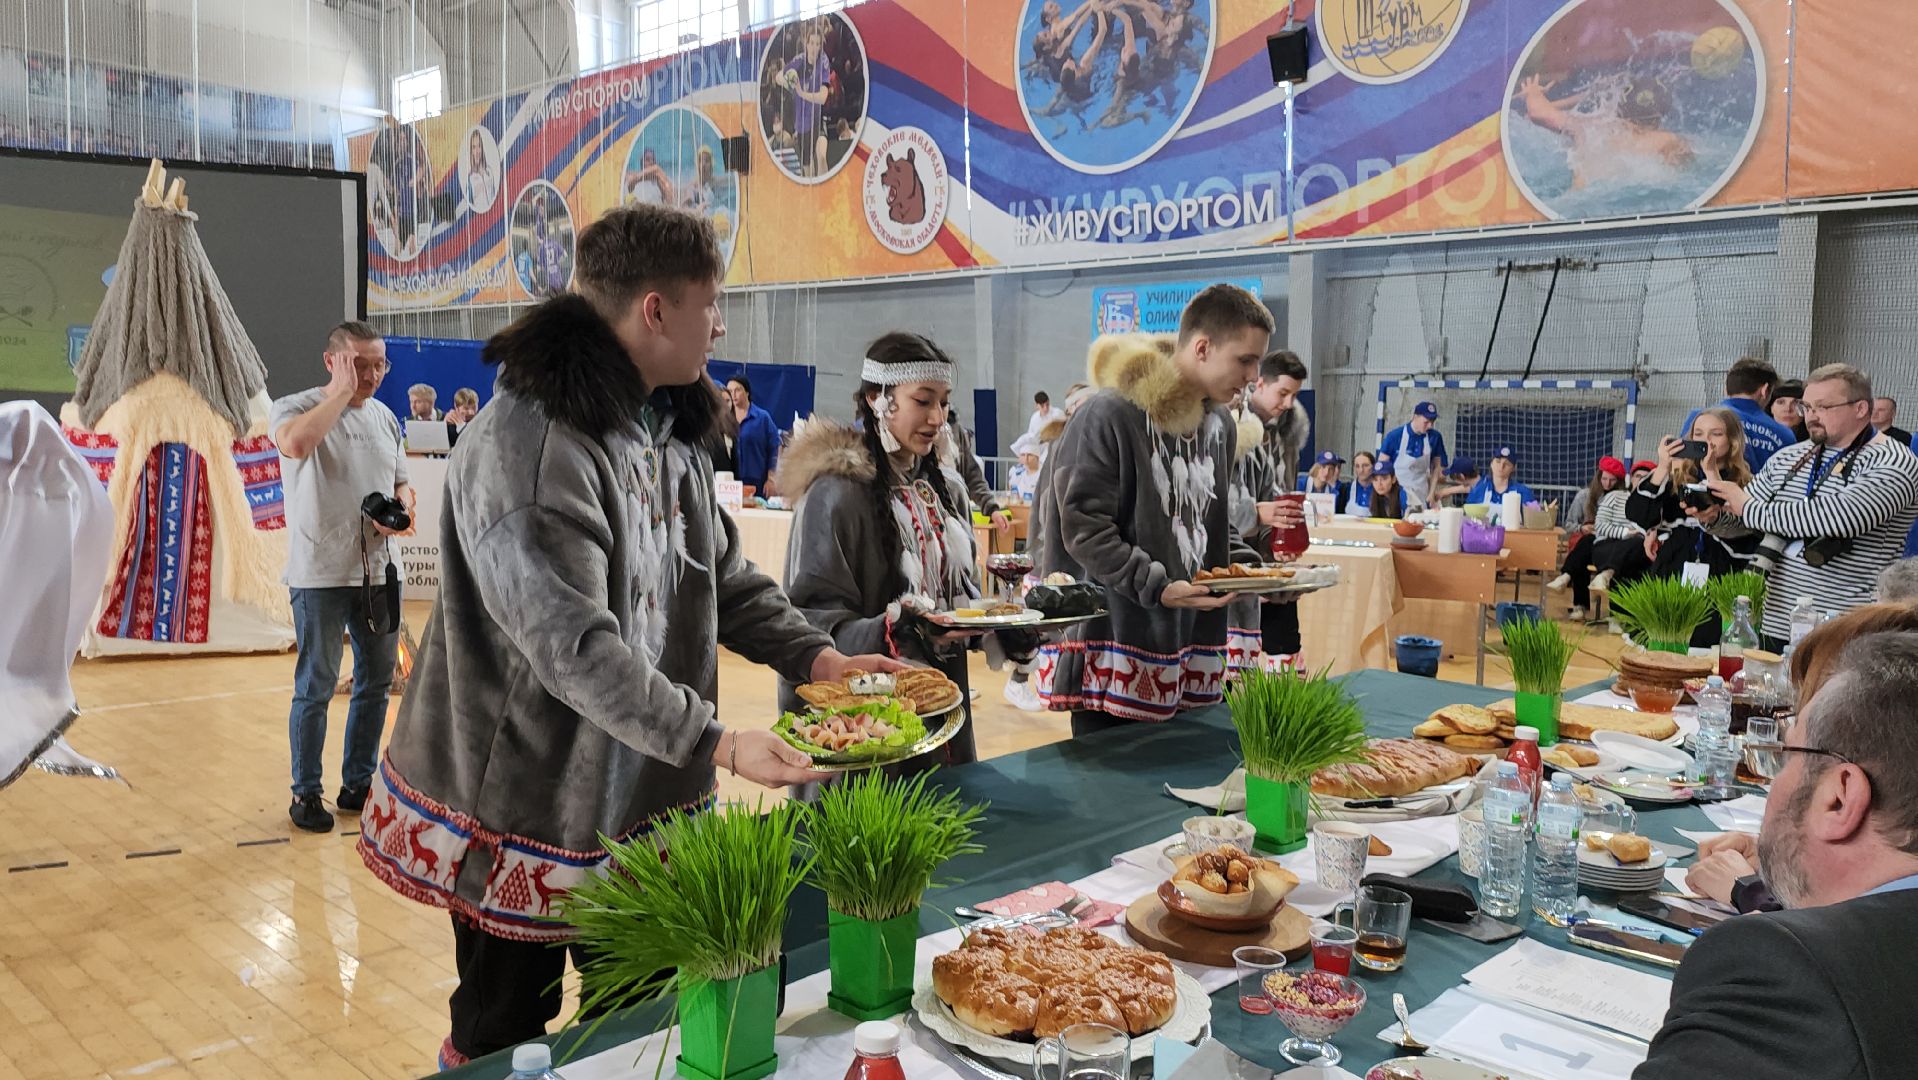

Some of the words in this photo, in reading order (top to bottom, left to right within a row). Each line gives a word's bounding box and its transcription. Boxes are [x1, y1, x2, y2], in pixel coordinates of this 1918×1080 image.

[527, 73, 648, 123] ЖИВУСПОРТОМ
[1015, 188, 1275, 245] #ЖИВУСПОРТОМ
[1146, 288, 1199, 305] УЧИЛИЩ
[1146, 310, 1179, 325] ОЛИМ
[0, 336, 27, 346] 024
[400, 546, 439, 557] рство
[402, 561, 435, 572] туры
[407, 575, 439, 586] обла
